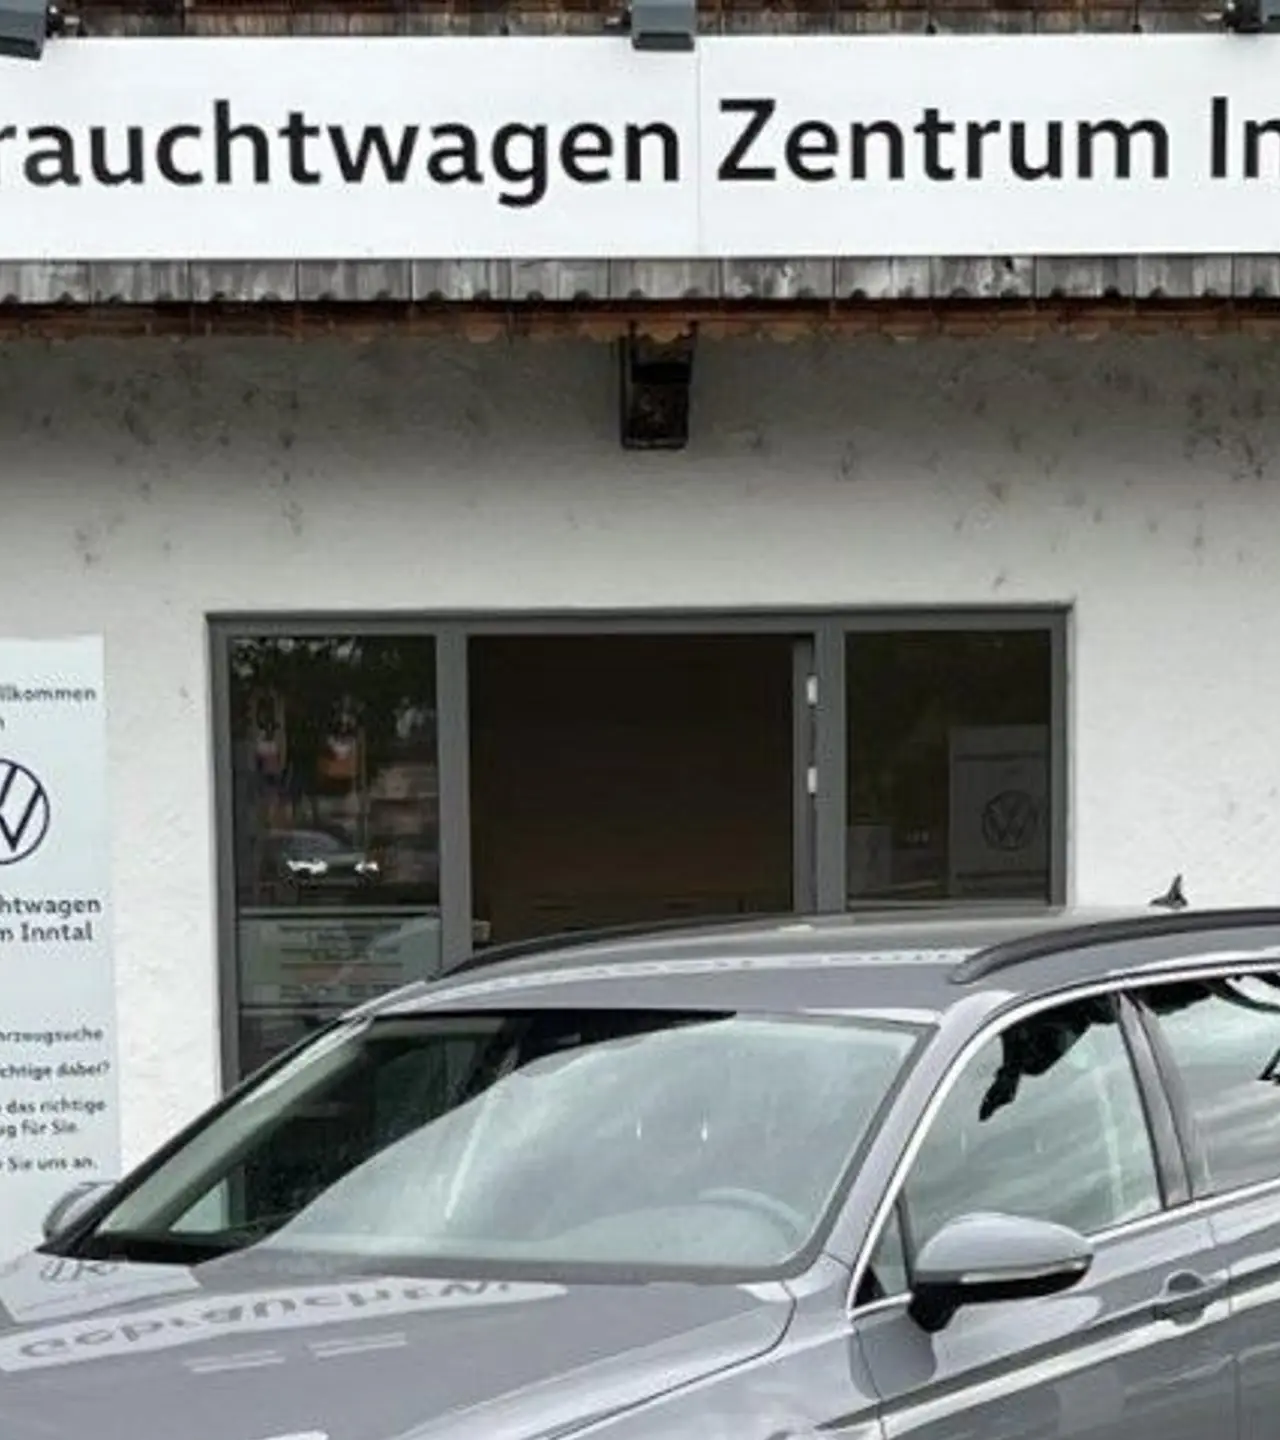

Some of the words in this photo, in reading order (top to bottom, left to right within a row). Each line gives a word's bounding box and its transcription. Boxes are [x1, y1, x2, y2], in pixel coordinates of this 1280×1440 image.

[718, 98, 1169, 182] Zentrum
[21, 921, 92, 941] Inntal
[6, 1099, 36, 1113] das
[40, 1098, 106, 1115] richtige
[7, 1157, 32, 1171] Sie
[37, 1158, 67, 1171] uns
